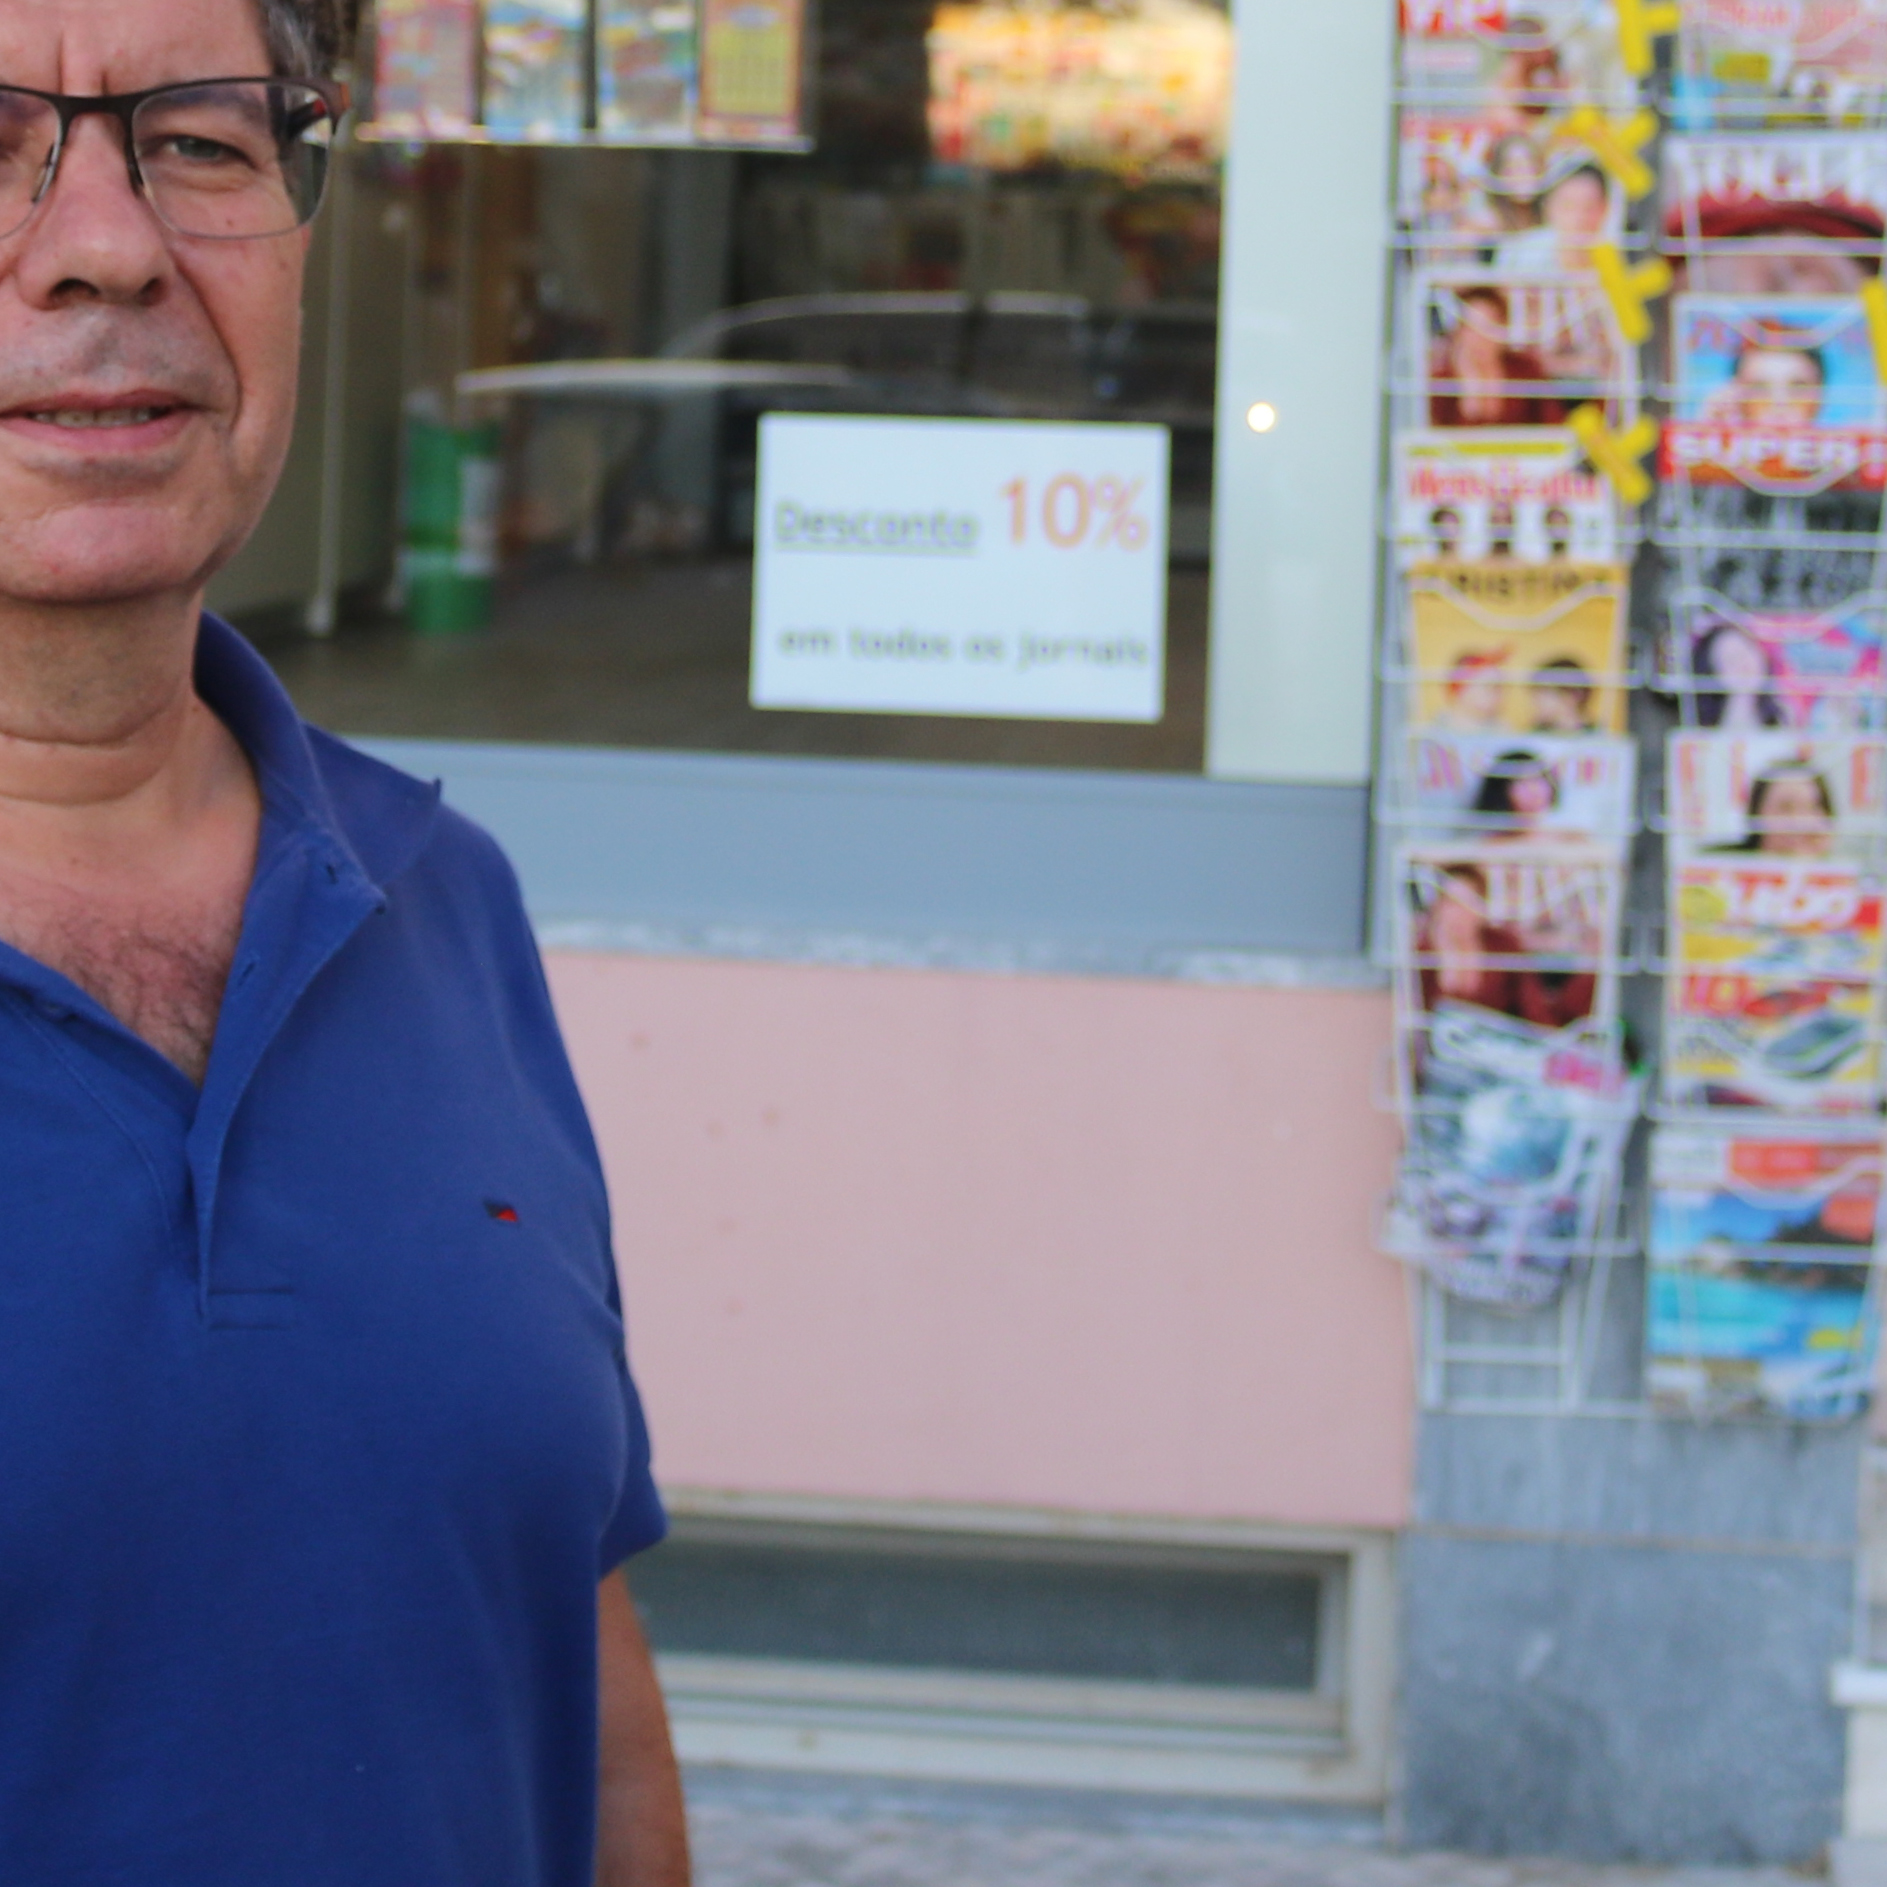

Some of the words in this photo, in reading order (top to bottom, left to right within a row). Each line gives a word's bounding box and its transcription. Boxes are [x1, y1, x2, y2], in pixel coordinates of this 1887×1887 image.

[774, 499, 981, 548] Desconto
[1000, 472, 1150, 552] 10%
[779, 630, 835, 657] em
[850, 628, 950, 661] todos
[965, 634, 1004, 662] os
[1016, 632, 1148, 671] jornais
